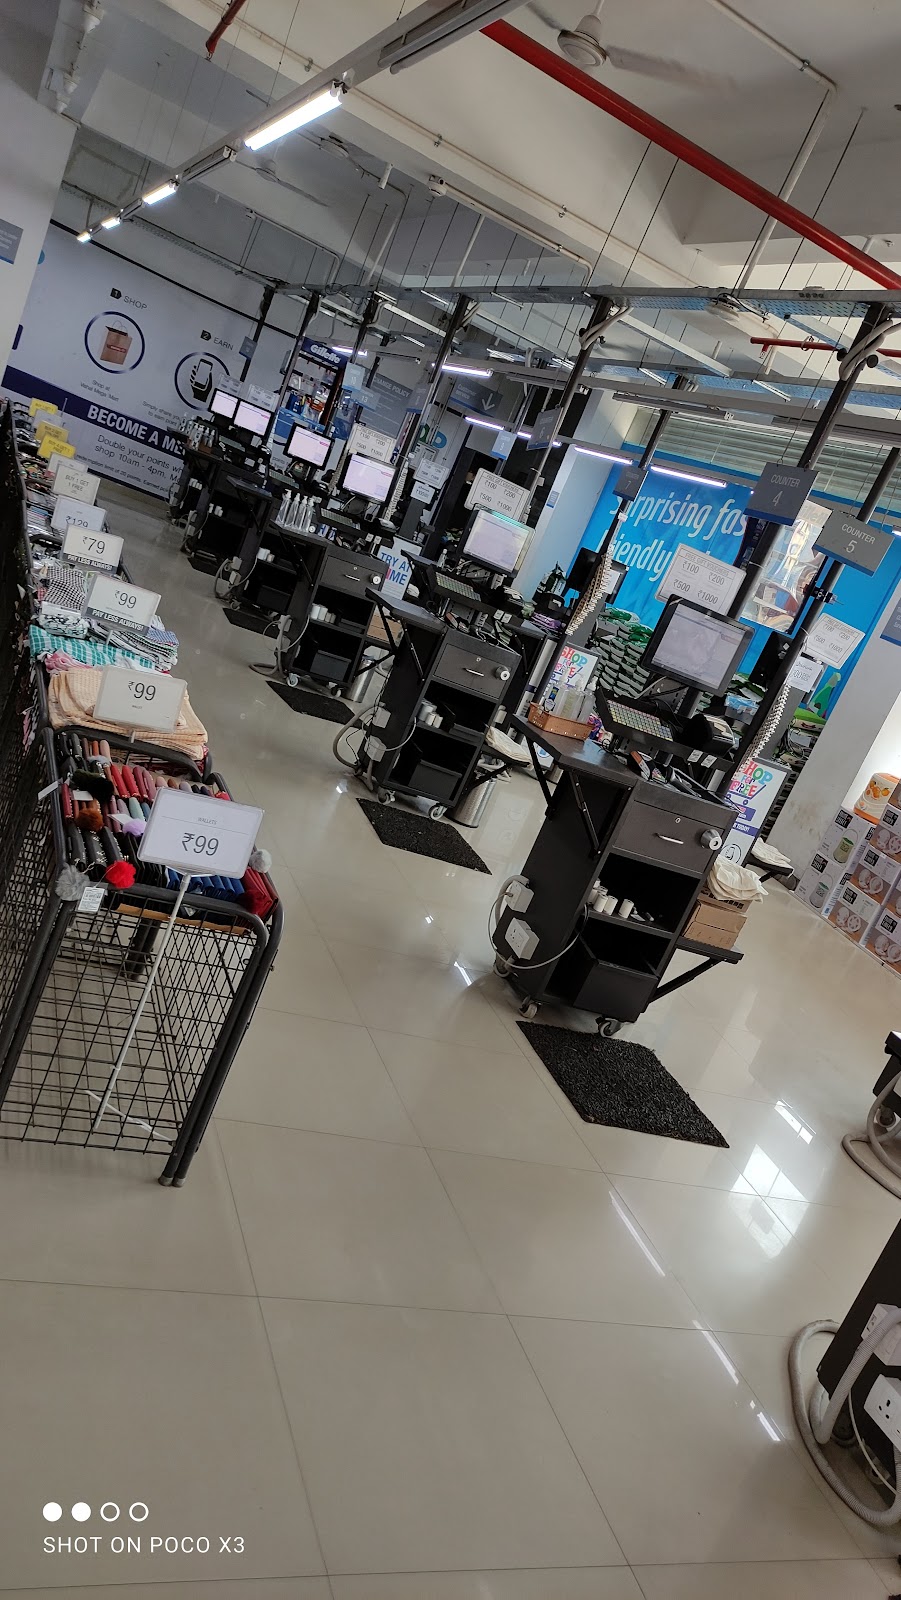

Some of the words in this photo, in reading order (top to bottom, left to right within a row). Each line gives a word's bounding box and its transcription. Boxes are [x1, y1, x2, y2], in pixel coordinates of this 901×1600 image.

[124, 295, 147, 309] SHOP
[213, 337, 234, 351] EARN
[310, 344, 342, 364] Gillette
[92, 380, 104, 389] Shop
[392, 385, 411, 397] POLICY
[87, 404, 148, 440] BECOME
[148, 430, 159, 445] A
[97, 434, 126, 451] Double
[128, 448, 146, 459] your
[146, 455, 170, 469] points
[95, 445, 115, 458] shop
[119, 453, 140, 467] 10am
[147, 465, 167, 479] 4pm.
[65, 474, 76, 482] BUY
[72, 483, 84, 492] FREE
[770, 474, 801, 488] COUNTER
[772, 490, 783, 507] 4
[609, 492, 713, 538] rprising
[841, 523, 876, 545] COUNTER
[82, 535, 106, 555] ₹79
[845, 540, 858, 554] 5
[380, 552, 399, 568] TRY
[682, 560, 700, 574] ₹100
[708, 572, 725, 586] ₹200
[114, 589, 137, 609] ₹99
[673, 578, 691, 592] ₹500
[697, 590, 719, 604] ₹1000
[91, 609, 104, 618] PAY
[103, 613, 120, 623] LESS
[118, 618, 144, 631] ALWAYS!
[127, 680, 156, 701] ₹99
[743, 760, 773, 785] HOP
[729, 780, 758, 797] FREE
[181, 831, 219, 856] ₹99
